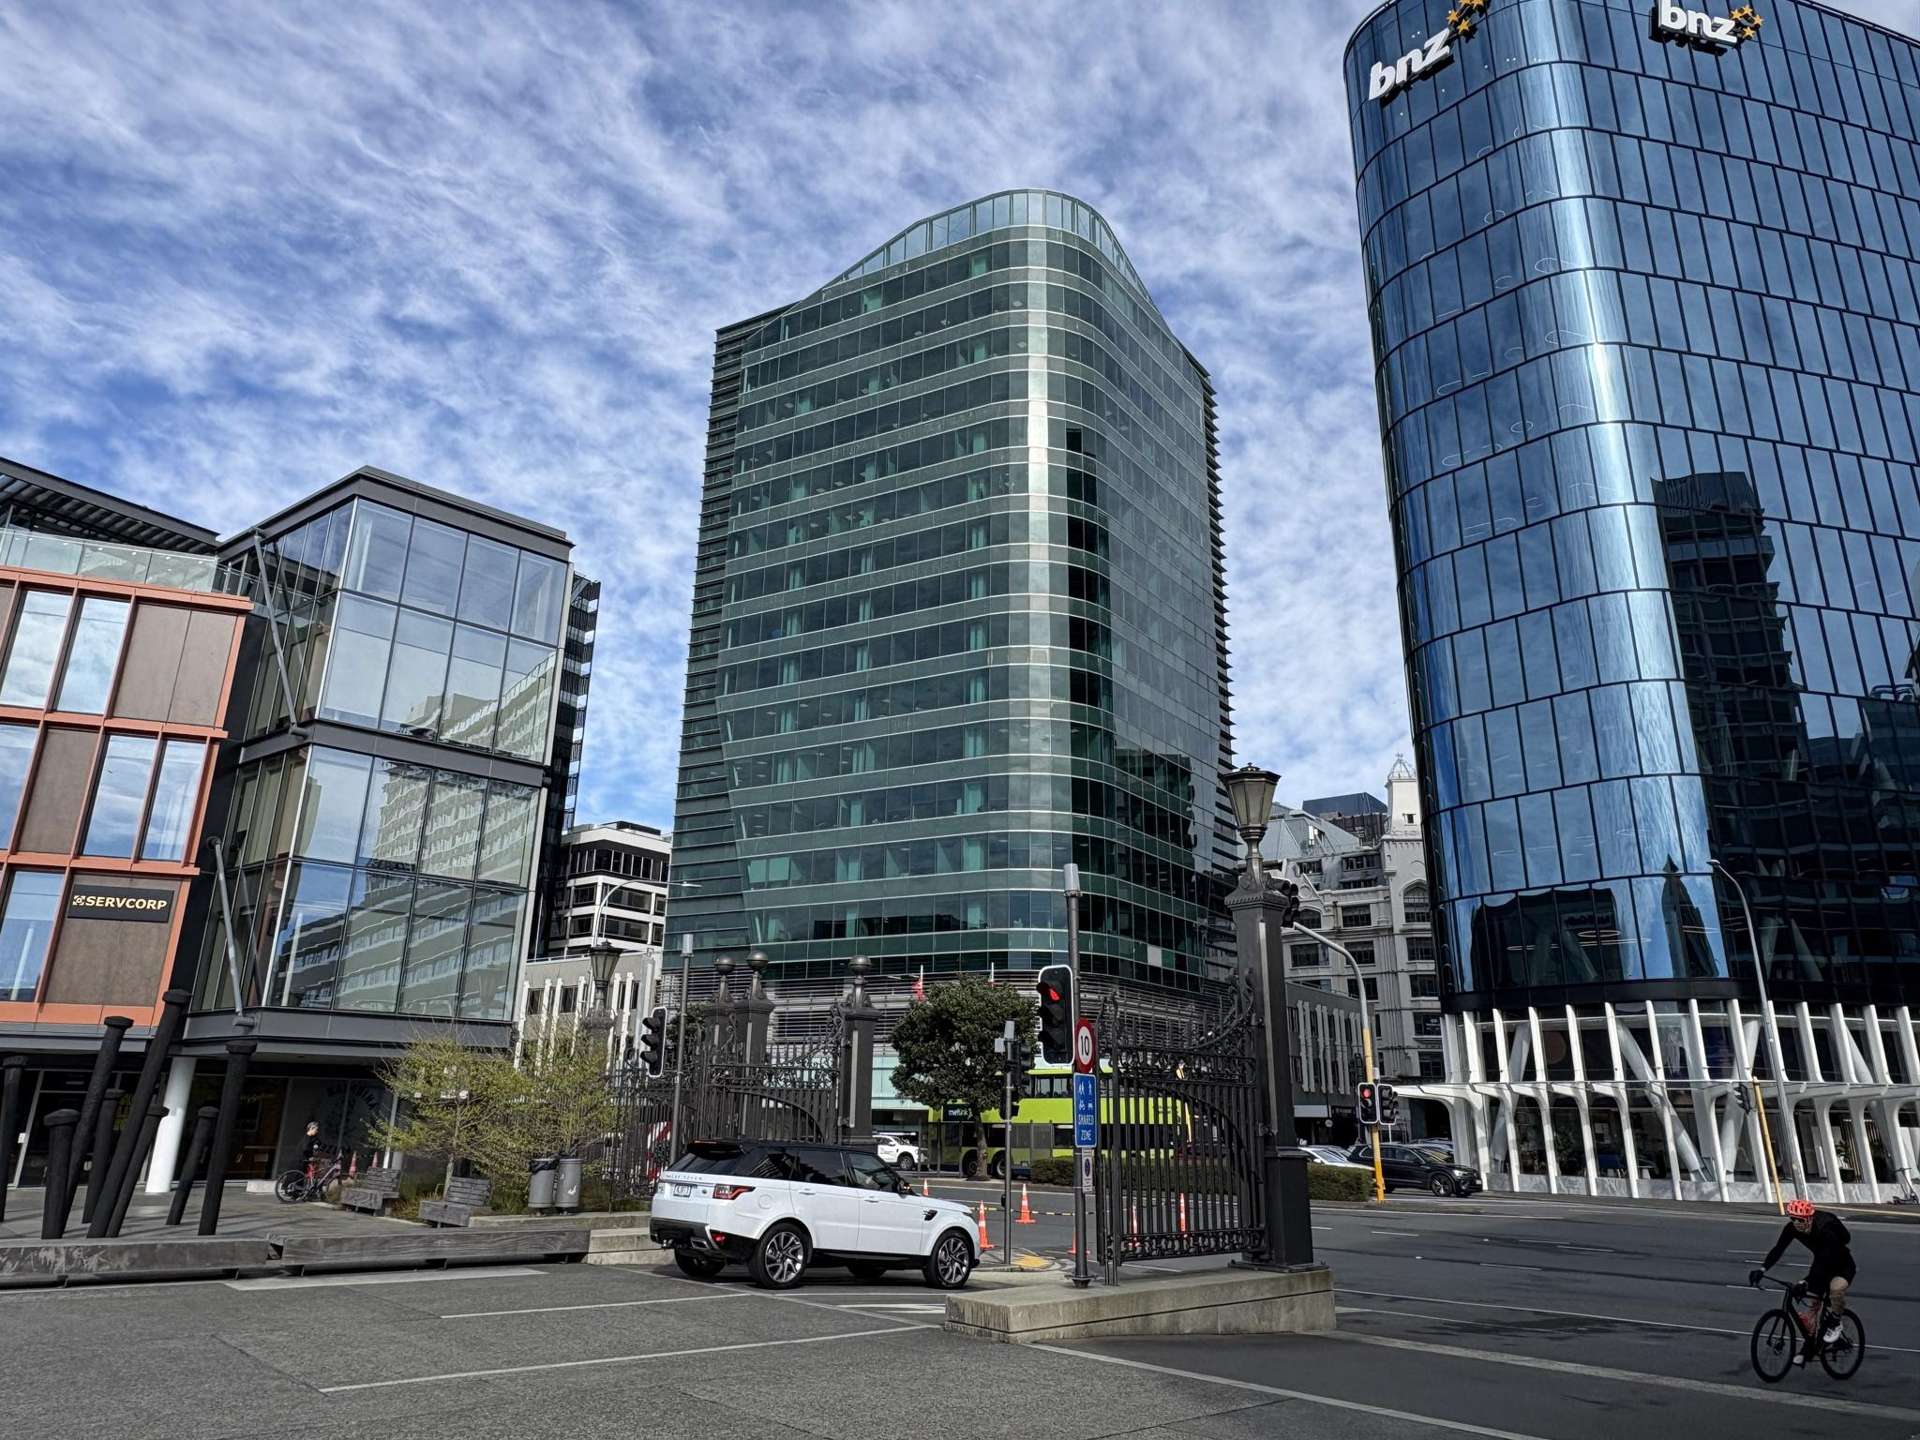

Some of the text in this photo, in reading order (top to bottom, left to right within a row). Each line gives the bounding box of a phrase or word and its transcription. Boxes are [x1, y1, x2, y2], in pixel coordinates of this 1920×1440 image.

[1658, 0, 1737, 43] bnz
[1369, 27, 1450, 101] bnz
[85, 895, 168, 910] SERVCORP
[1080, 1035, 1090, 1056] 10
